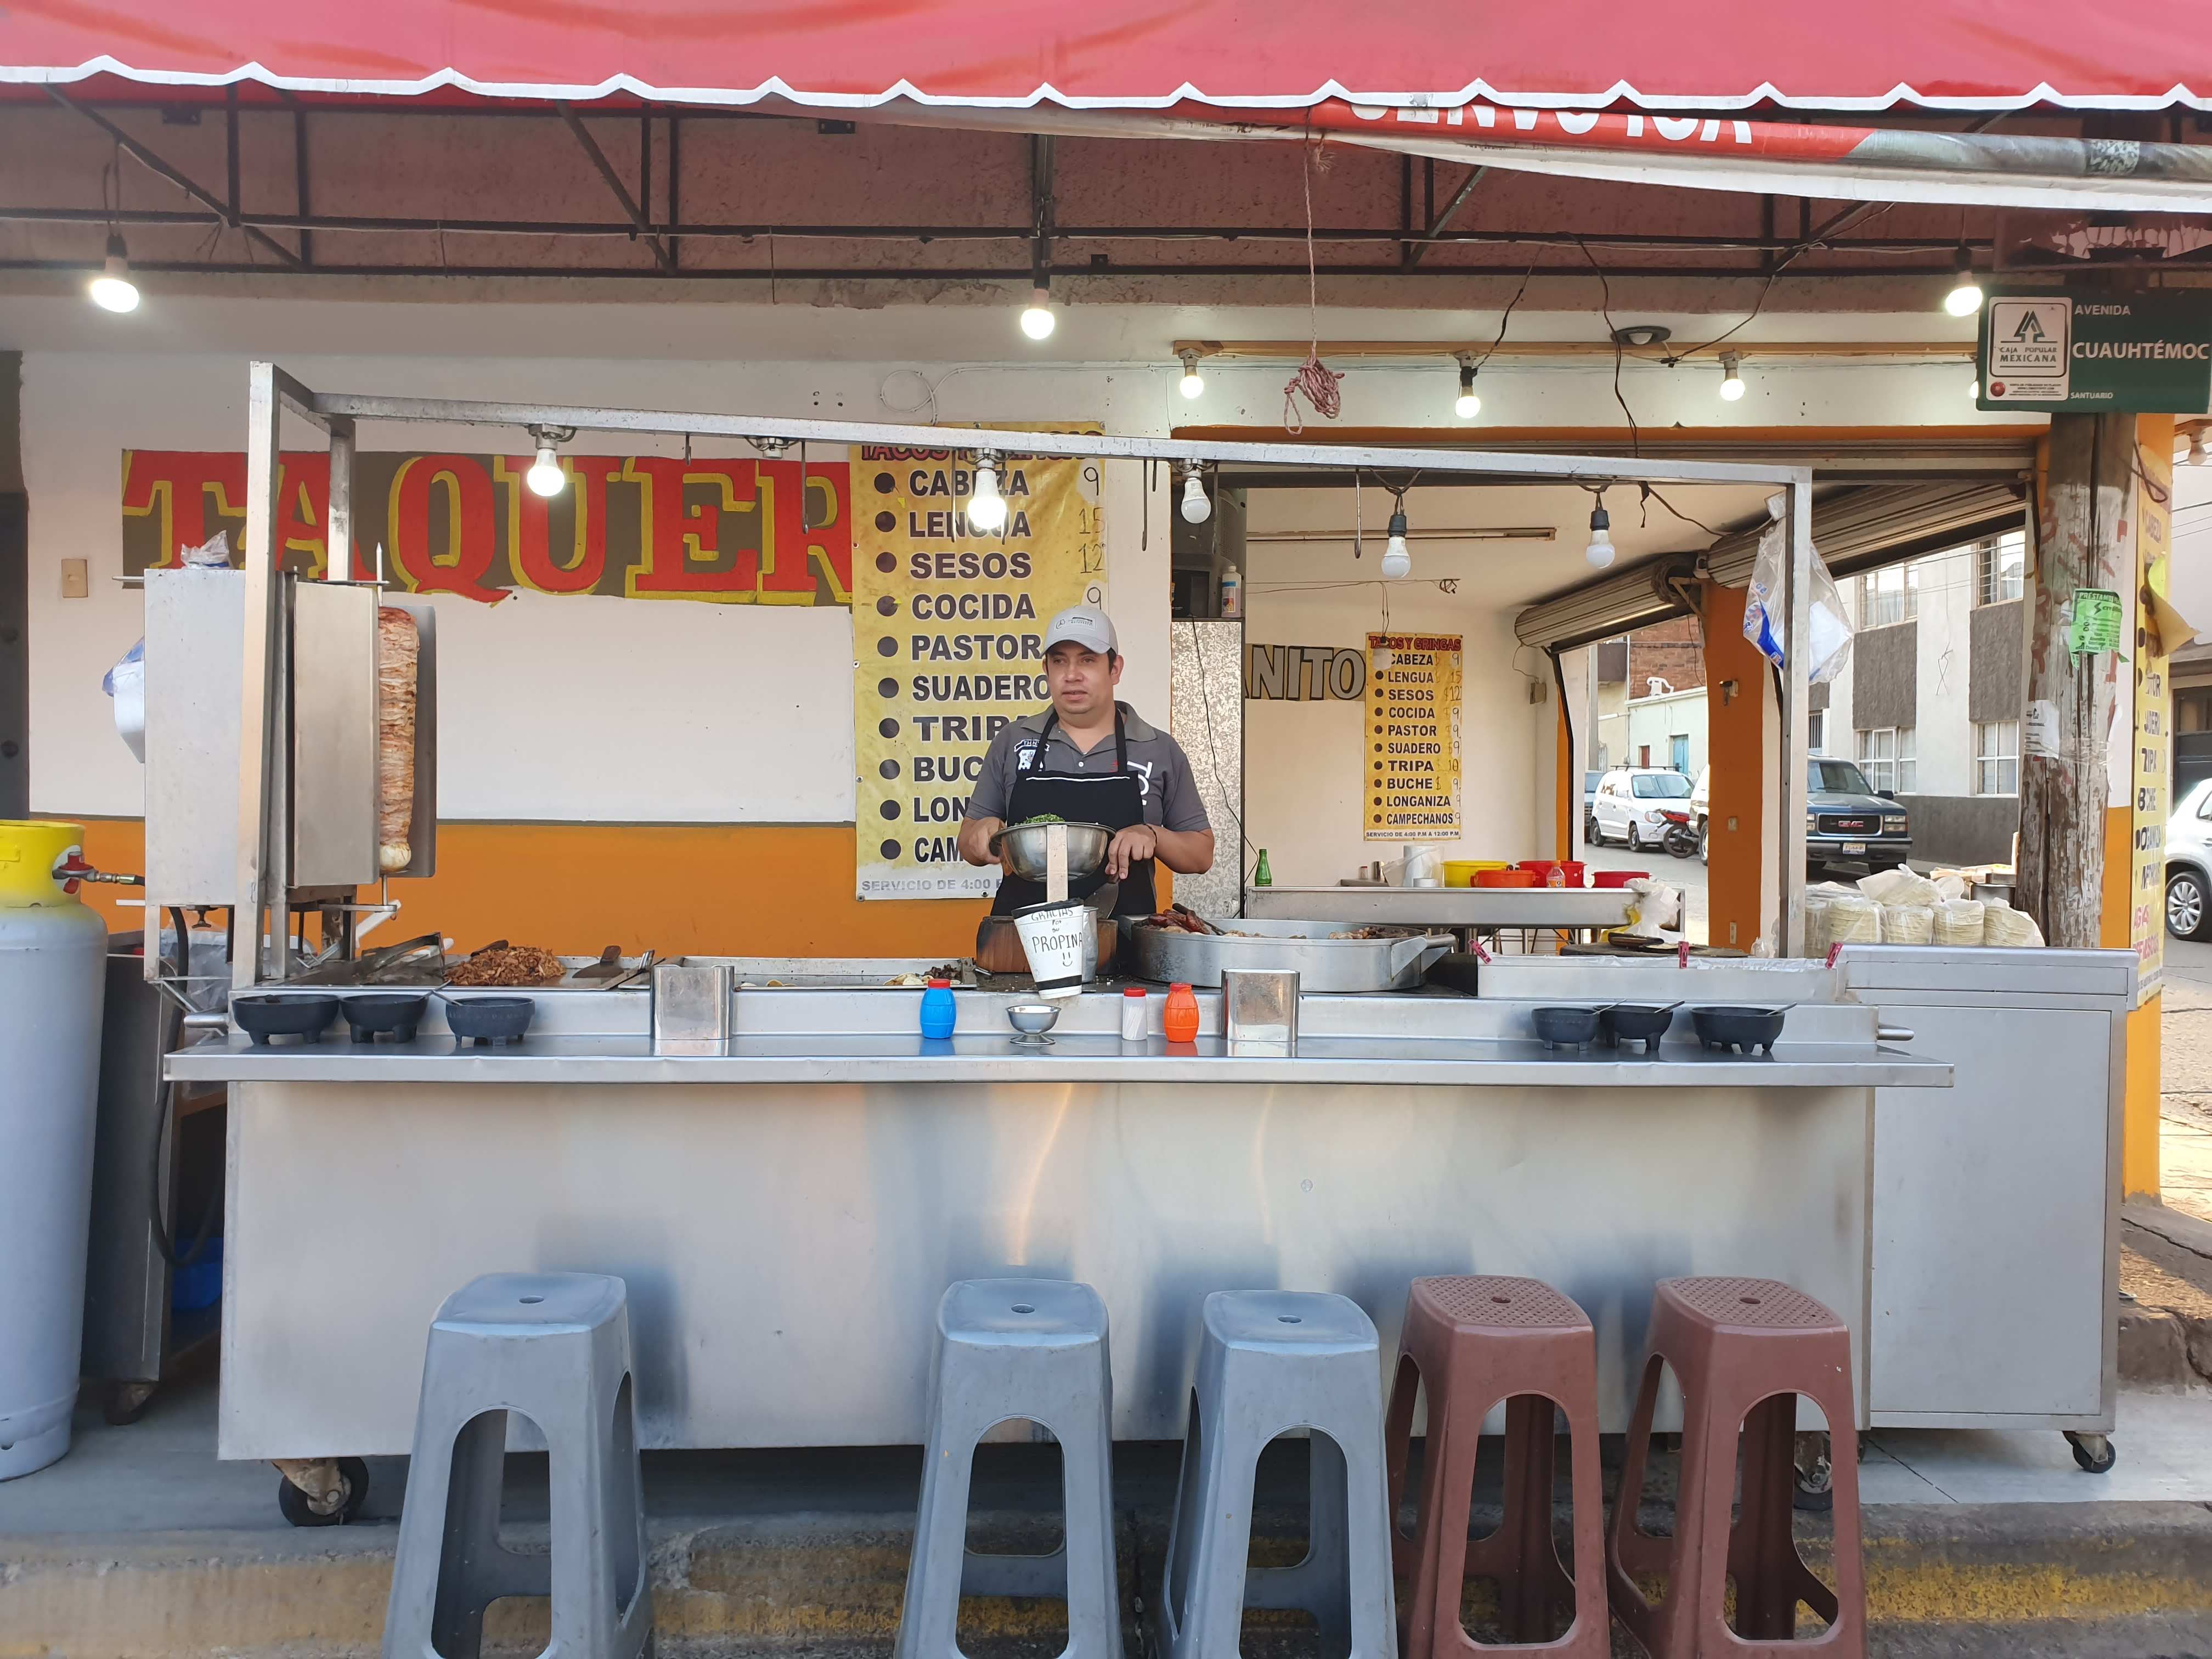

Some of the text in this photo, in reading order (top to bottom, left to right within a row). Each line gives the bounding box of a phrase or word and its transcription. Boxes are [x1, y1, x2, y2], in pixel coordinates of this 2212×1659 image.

[2074, 304, 2131, 316] AVENIDA
[2072, 340, 2210, 359] CUAUHTÉMOC
[2000, 354, 2057, 363] MEXICANA
[1083, 466, 1100, 496] 9
[1079, 507, 1105, 535] 15
[910, 551, 1032, 579] SESOS
[1086, 586, 1102, 611] 9
[911, 593, 1036, 620] COCIDA
[911, 634, 1043, 661] PASTOR
[1404, 637, 1413, 650] Y
[1414, 638, 1462, 651] GRINGAS
[1388, 671, 1434, 683] LENGUA
[912, 675, 1051, 701] SUADERO
[1388, 689, 1434, 701] SESOS
[1389, 707, 1435, 719] COCIDA
[1388, 725, 1437, 736] PASTOR
[1388, 742, 1441, 754] SUADERO
[1388, 760, 1434, 771] TRIPA
[1387, 778, 1432, 789] BUCHE
[1386, 795, 1451, 806] LONGANIZA
[1386, 812, 1453, 825] CAMPECHANOS
[861, 878, 932, 891] SERVICIO
[936, 879, 956, 890] DE
[961, 878, 991, 889] 4:00
[1032, 932, 1083, 953] PROPINA
